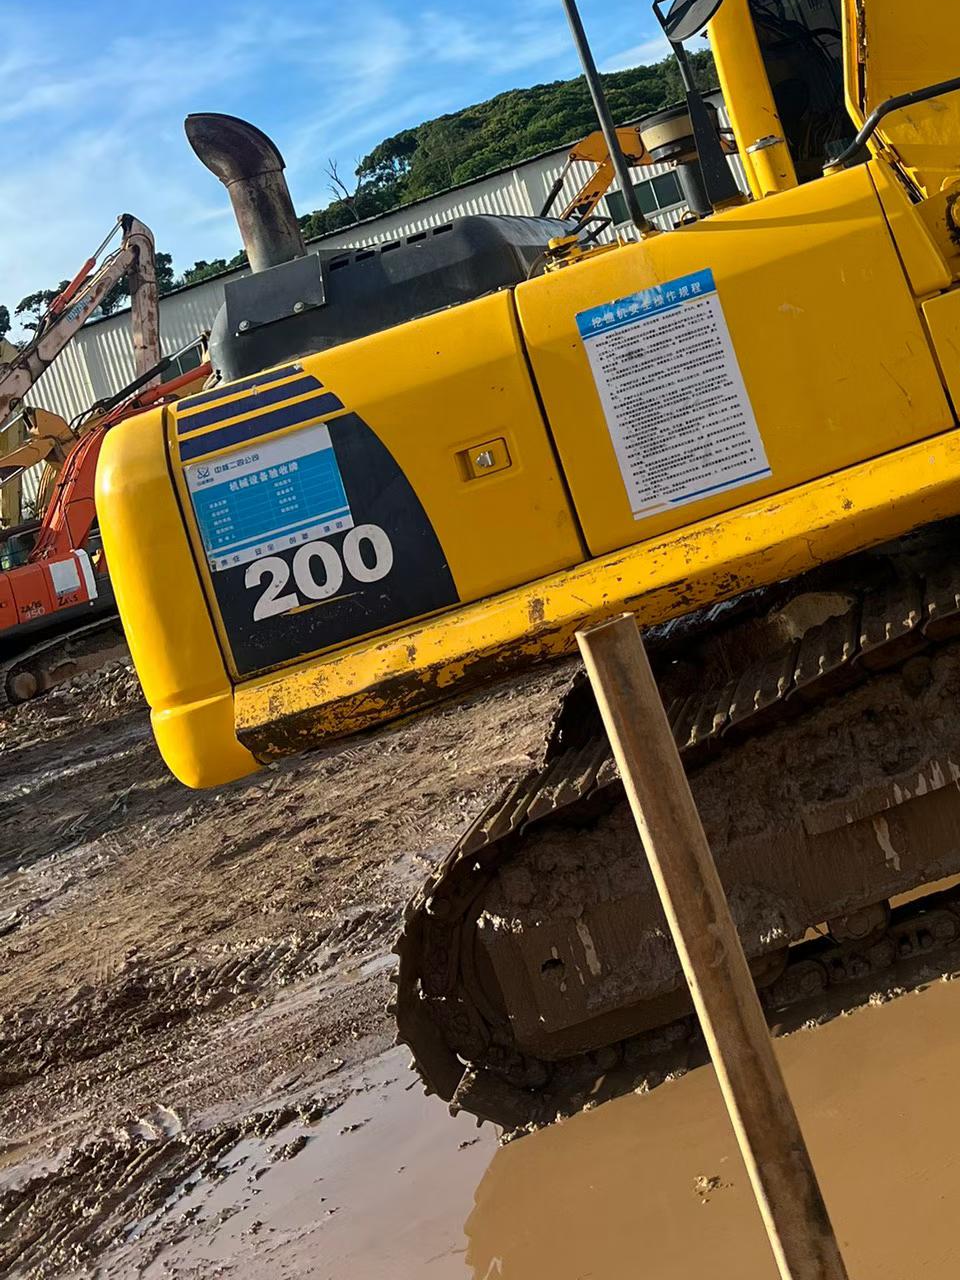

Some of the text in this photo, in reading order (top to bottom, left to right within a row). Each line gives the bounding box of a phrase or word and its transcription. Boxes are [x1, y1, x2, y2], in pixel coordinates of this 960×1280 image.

[591, 282, 703, 329] 挖掘机安全操作规程
[244, 523, 393, 622] 200
